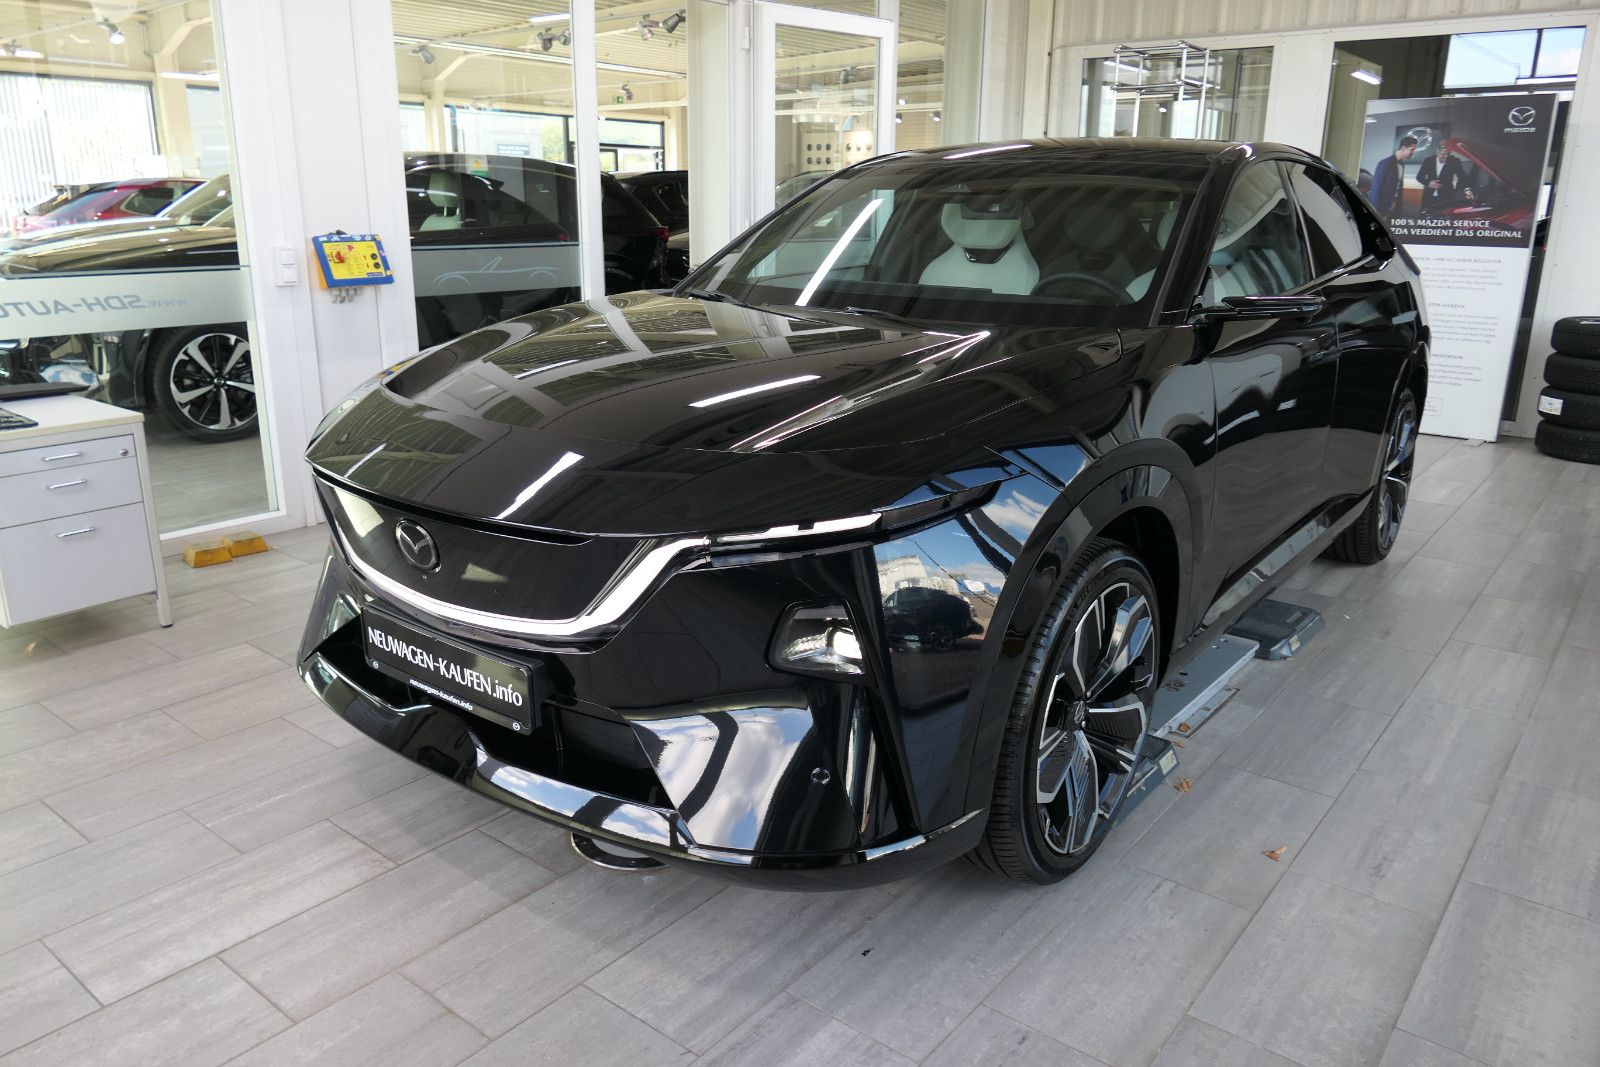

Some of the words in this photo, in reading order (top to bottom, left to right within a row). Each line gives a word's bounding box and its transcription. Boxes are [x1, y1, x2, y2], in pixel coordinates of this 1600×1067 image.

[1390, 218, 1407, 226] 100
[1417, 219, 1451, 227] MAZDA
[1453, 219, 1491, 228] SERVICE
[1390, 227, 1409, 235] ZDA
[1410, 228, 1453, 236] VERDIENT
[1455, 229, 1474, 237] DAS
[1476, 230, 1522, 238] ORIGINAL
[367, 626, 523, 707] NEUWAGEN-KAUFEN.info
[409, 678, 473, 711] neuwagen-kaufen.info
